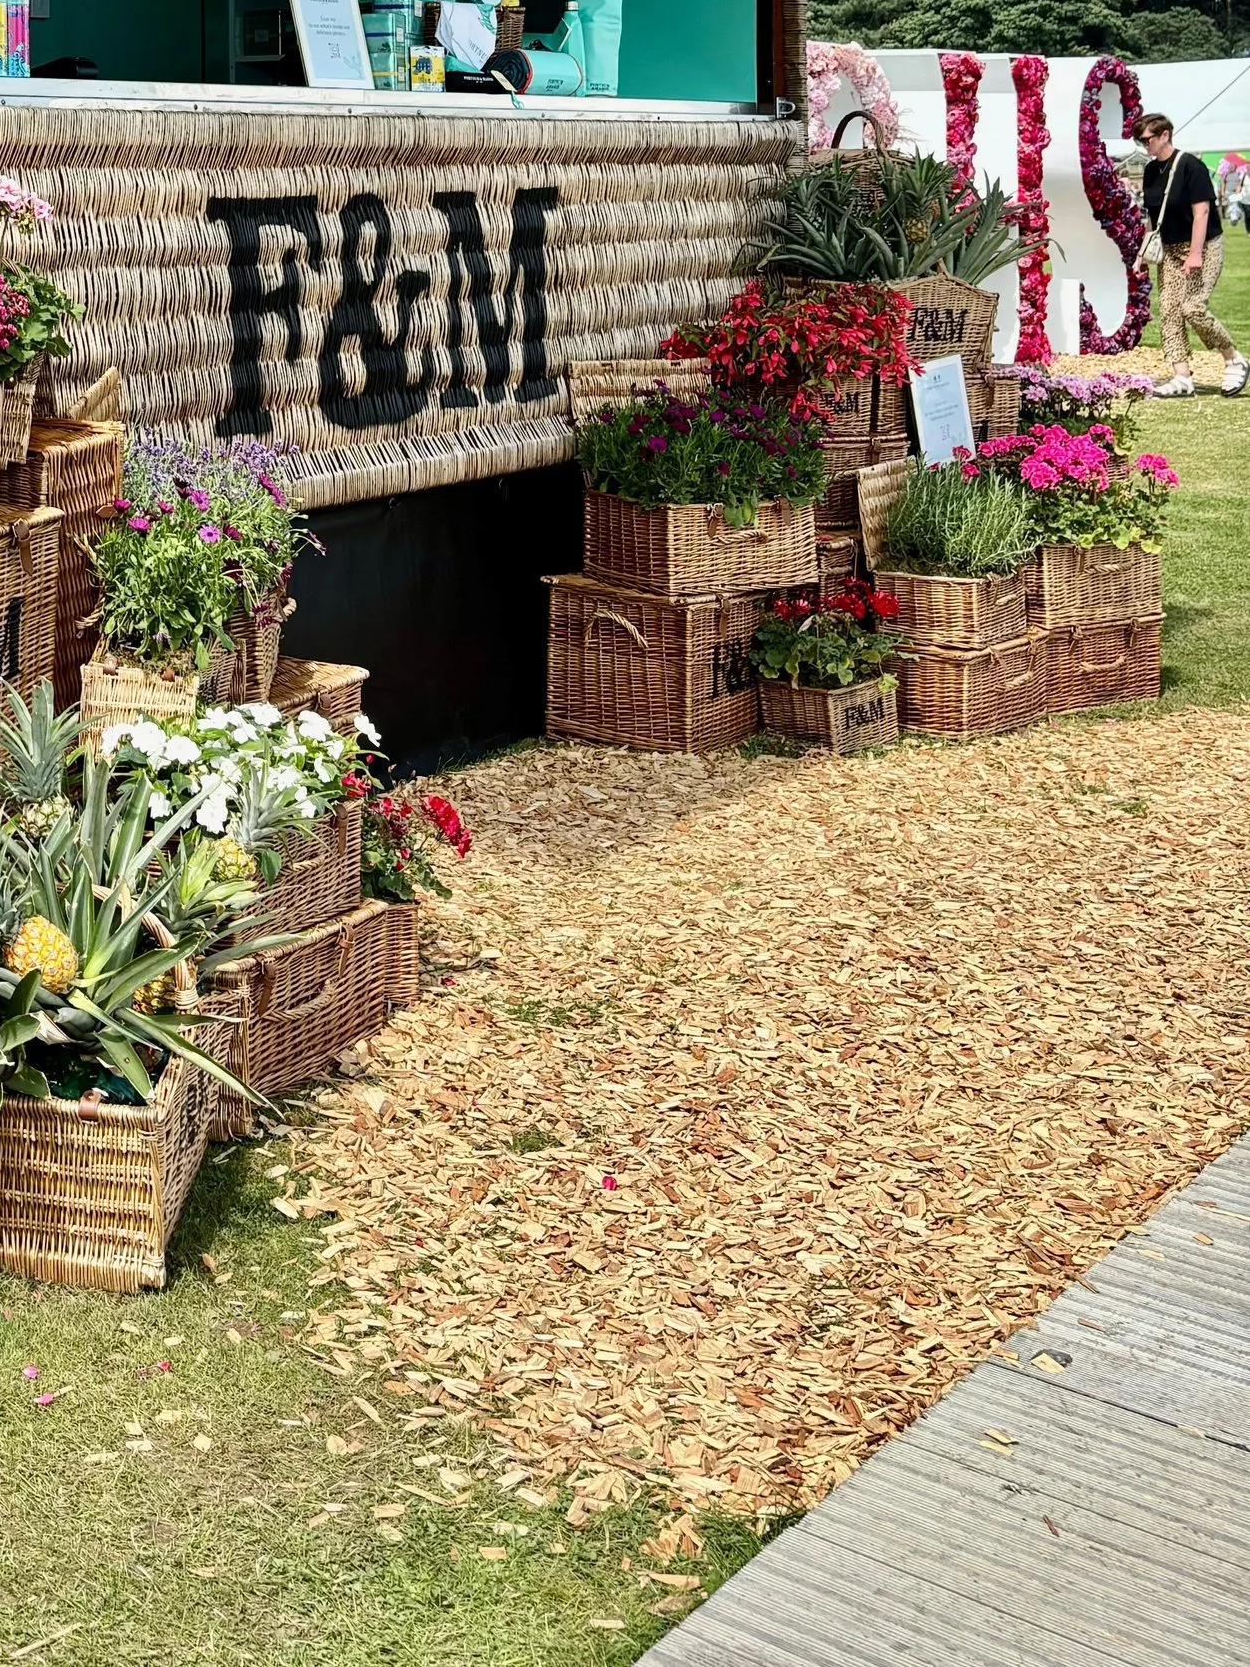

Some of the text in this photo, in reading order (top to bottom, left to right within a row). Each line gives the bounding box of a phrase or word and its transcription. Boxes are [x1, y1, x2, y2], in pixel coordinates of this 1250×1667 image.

[206, 187, 558, 437] F&M
[910, 307, 968, 342] F&M
[845, 697, 885, 729] F&M
